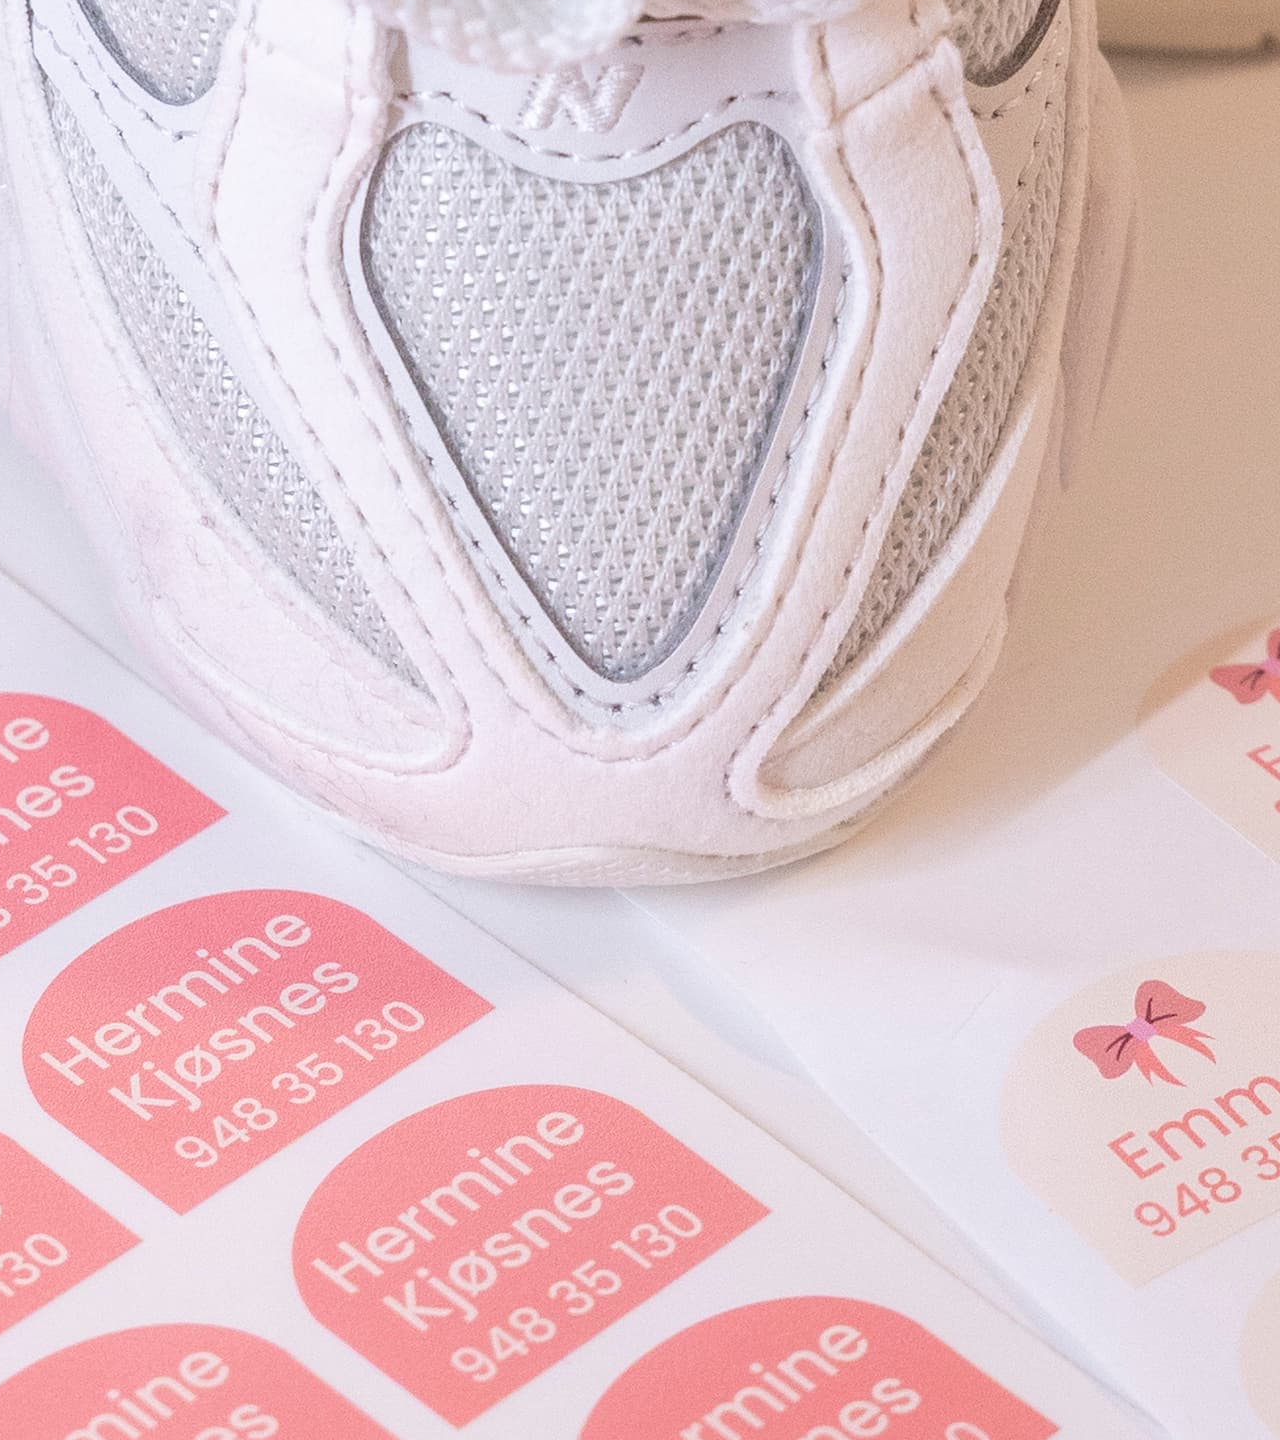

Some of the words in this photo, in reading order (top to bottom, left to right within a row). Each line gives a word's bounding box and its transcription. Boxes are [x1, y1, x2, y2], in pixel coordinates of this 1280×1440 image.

[4, 853, 78, 906] 35
[67, 804, 159, 865] 130
[39, 913, 312, 1086] Hermine
[107, 960, 360, 1121] Kjøsnes
[173, 1096, 279, 1168] 948
[270, 1051, 345, 1105] 35
[333, 1000, 426, 1062] 130
[311, 1109, 585, 1295] Hermine
[381, 1160, 635, 1332] Kjøsnes
[1132, 1166, 1243, 1237] 948
[450, 1305, 557, 1382] 948
[547, 1258, 622, 1315] 35
[609, 1203, 703, 1269] 130
